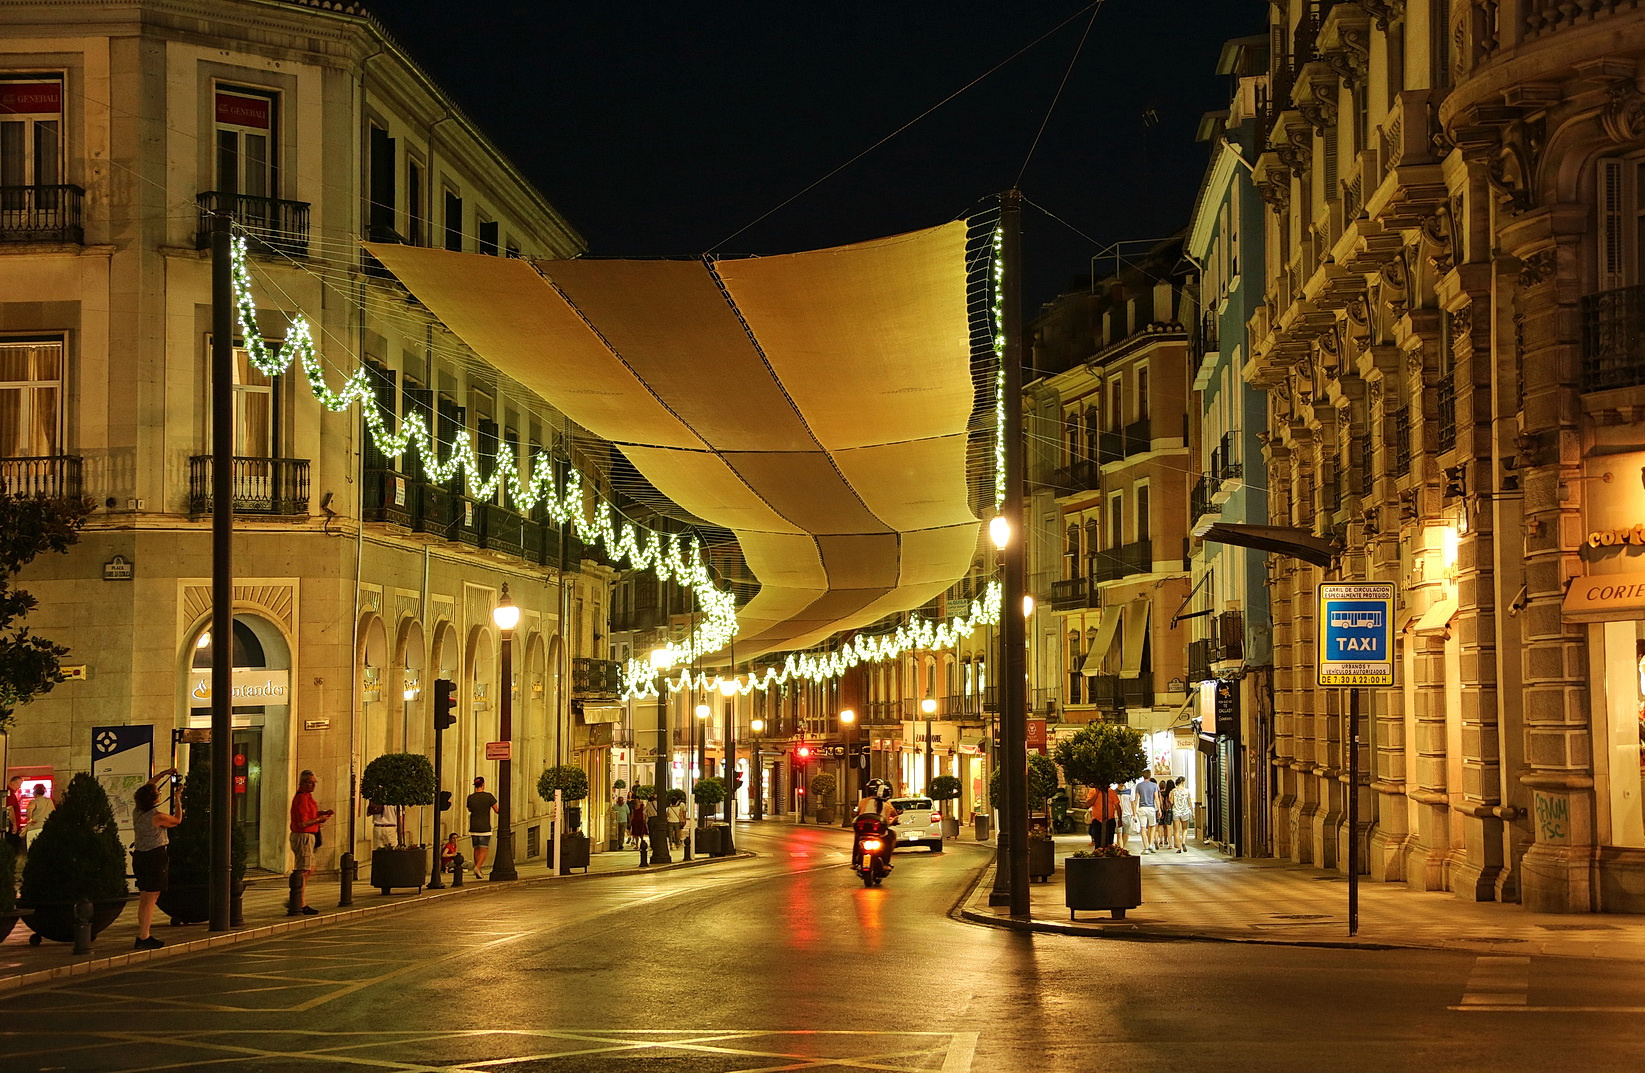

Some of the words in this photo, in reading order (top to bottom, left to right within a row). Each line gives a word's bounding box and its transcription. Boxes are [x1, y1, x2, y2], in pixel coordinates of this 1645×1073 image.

[17, 94, 59, 103] GENERALI
[230, 107, 266, 119] GENERALI
[1336, 637, 1377, 651] TAXI
[314, 677, 324, 686] 36
[1321, 676, 1332, 684] DE
[1333, 676, 1350, 684] 7:30
[1351, 676, 1358, 684] A
[1358, 676, 1380, 684] 22:00
